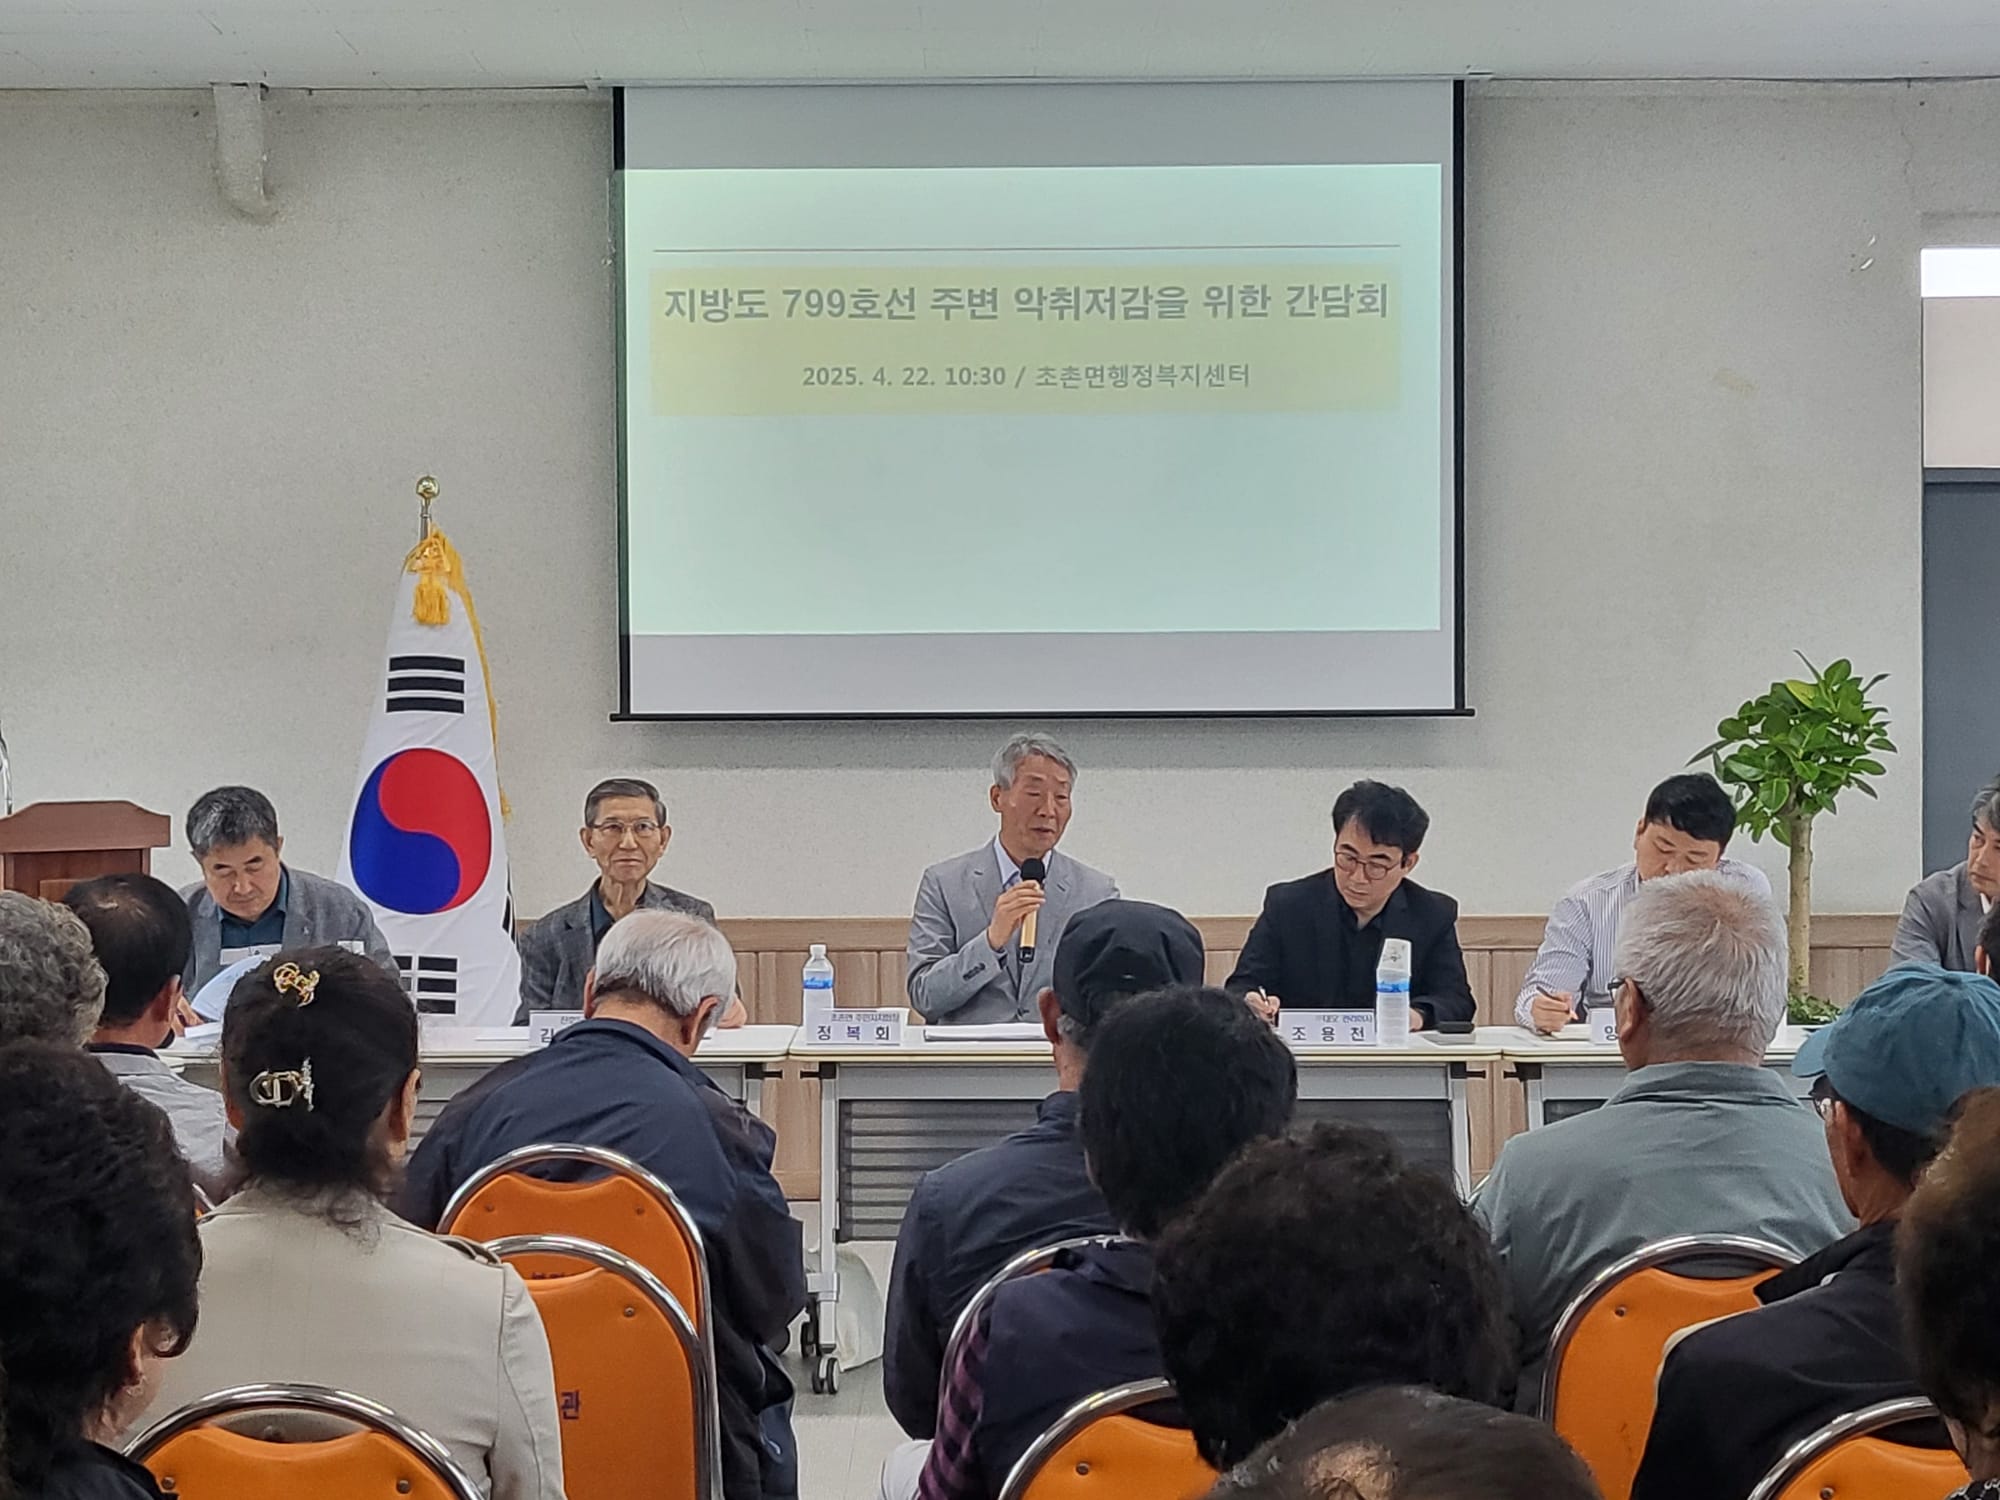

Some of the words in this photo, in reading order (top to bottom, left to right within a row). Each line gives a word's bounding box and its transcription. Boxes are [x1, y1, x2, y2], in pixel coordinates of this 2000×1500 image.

[664, 287, 770, 323] 지방도
[782, 286, 917, 321] 799호선
[930, 286, 999, 321] 주변
[1013, 285, 1190, 321] 악취저감을
[1202, 284, 1272, 319] 위한
[1286, 283, 1389, 319] 간담회
[802, 366, 864, 387] 2025.
[872, 366, 893, 387] 4.
[902, 366, 935, 387] 22.
[945, 366, 1006, 387] 10:30
[1035, 363, 1250, 390] 초촌면행정복지센터
